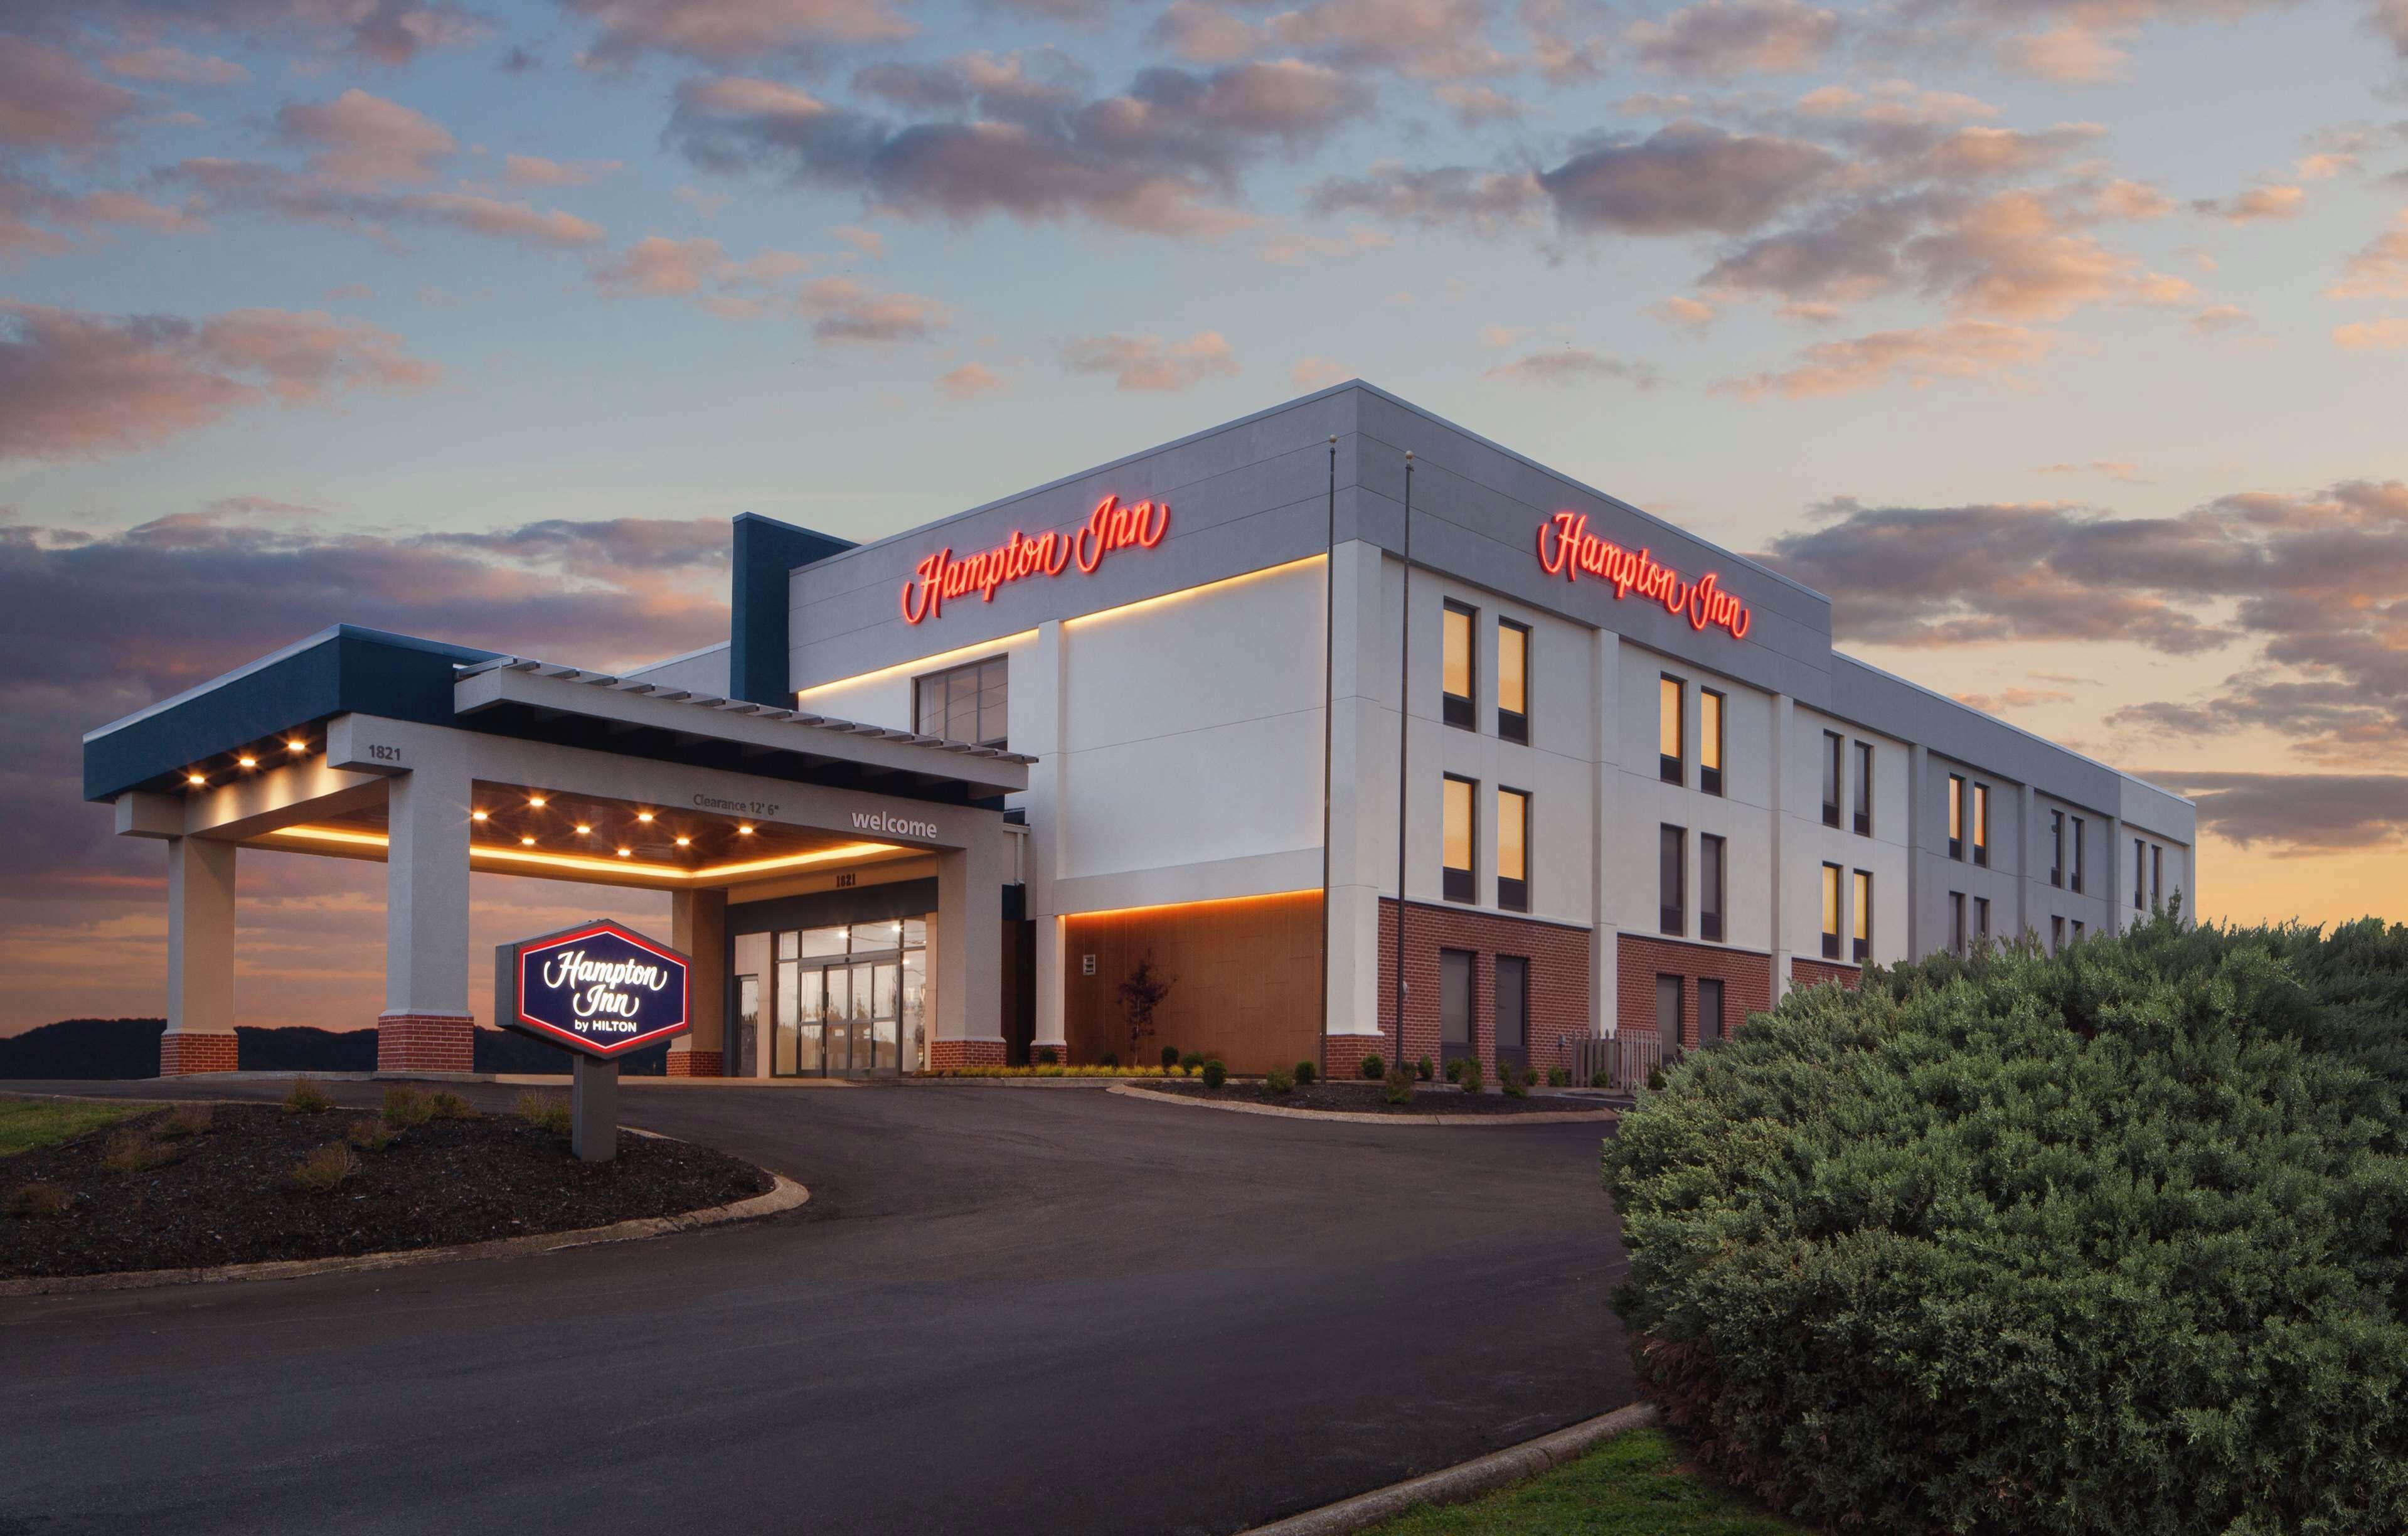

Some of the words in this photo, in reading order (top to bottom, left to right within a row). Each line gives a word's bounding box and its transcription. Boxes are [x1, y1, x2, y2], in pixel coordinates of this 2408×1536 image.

[902, 530, 1073, 624] Hampton
[1076, 495, 1171, 573] Inn
[1536, 512, 1687, 614] Hampton
[1686, 573, 1750, 639] Inn
[368, 744, 401, 761] 1821
[693, 793, 747, 812] Clearance
[750, 801, 765, 814] 12'
[767, 804, 779, 816] 6"
[851, 811, 937, 838] welcome
[836, 873, 856, 888] 1821
[543, 950, 668, 991] Hampton
[573, 984, 639, 1017] Inn
[575, 1019, 589, 1032] by
[592, 1020, 637, 1033] HILTON
